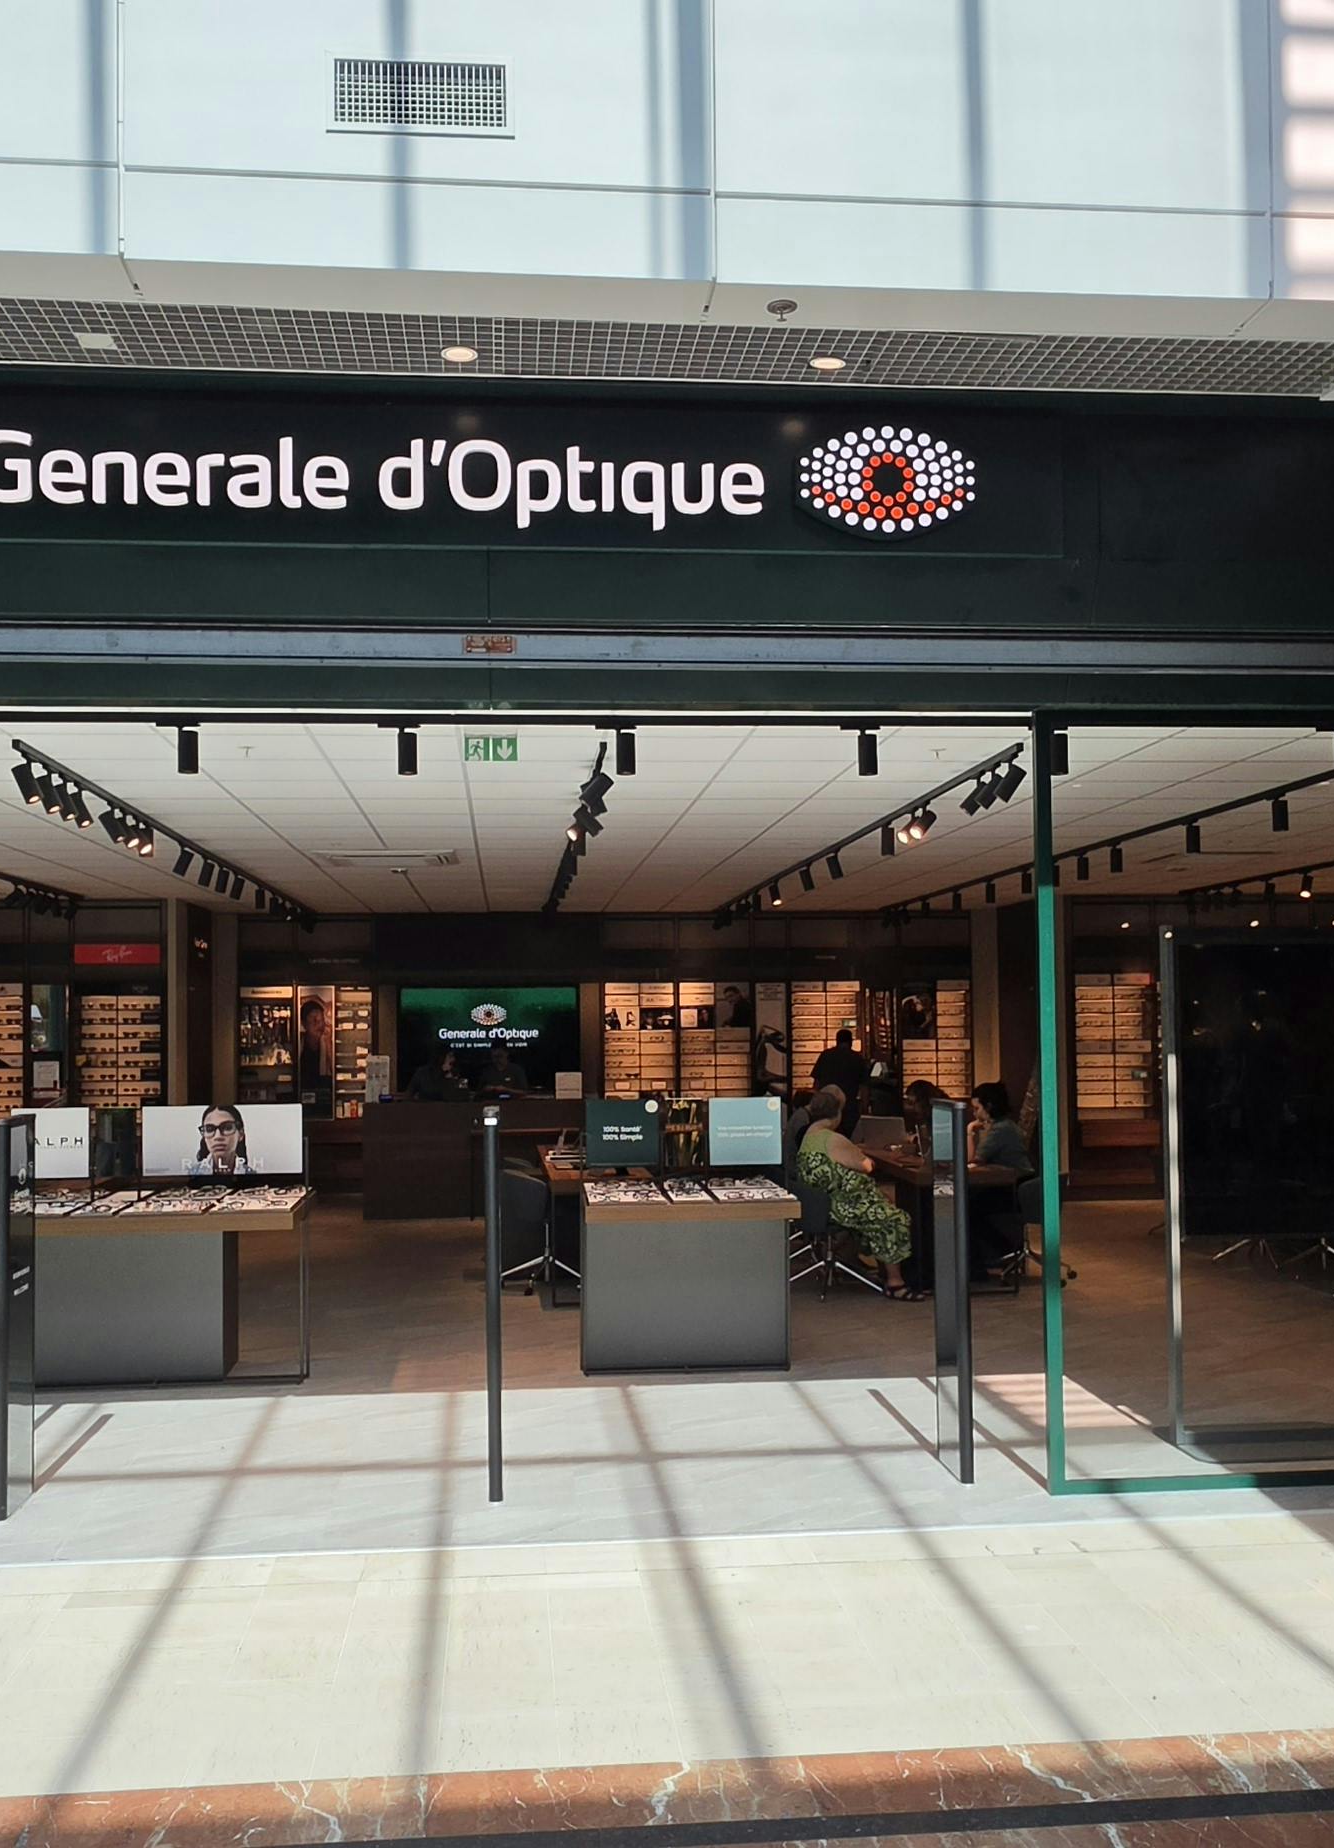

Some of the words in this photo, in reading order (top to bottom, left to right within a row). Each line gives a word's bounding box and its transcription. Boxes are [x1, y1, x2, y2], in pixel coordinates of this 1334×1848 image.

[378, 437, 765, 532] d'Optique
[439, 1028, 486, 1040] Generale
[488, 1027, 539, 1041] d'Optique
[620, 1133, 643, 1143] Simple
[182, 1157, 265, 1171] RALPH
